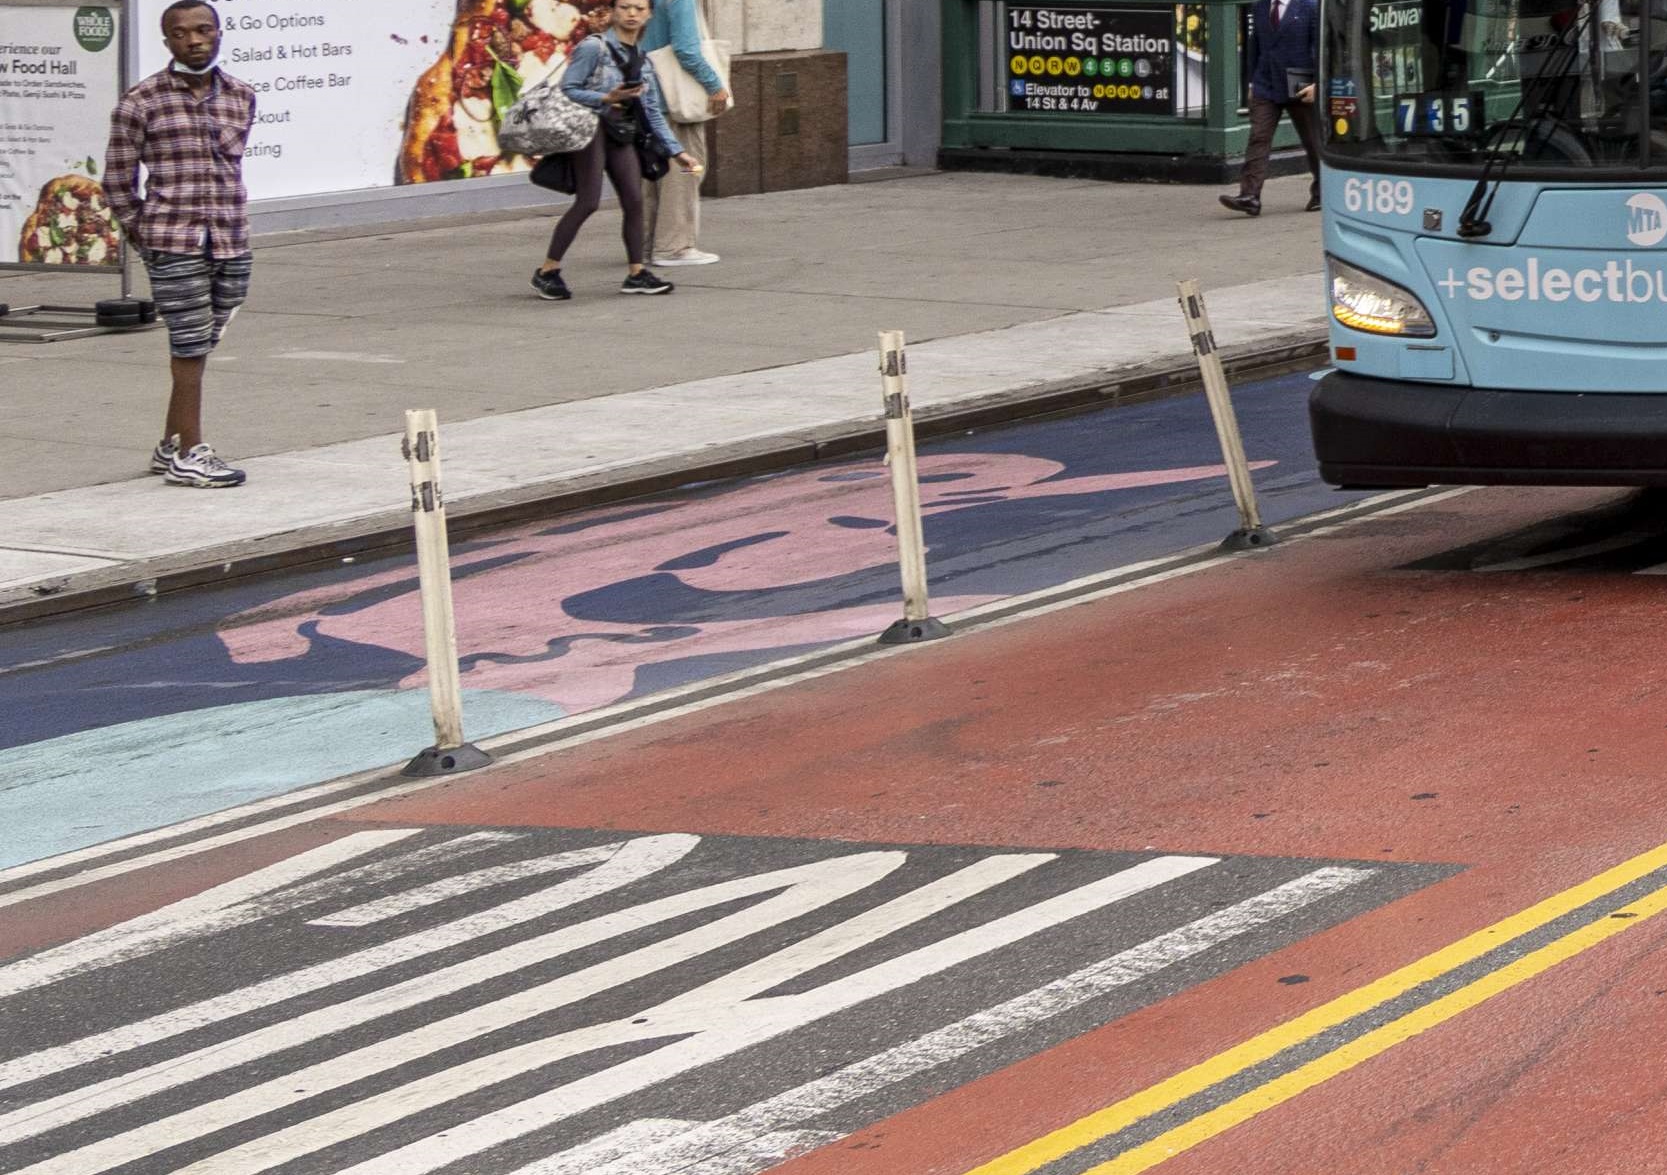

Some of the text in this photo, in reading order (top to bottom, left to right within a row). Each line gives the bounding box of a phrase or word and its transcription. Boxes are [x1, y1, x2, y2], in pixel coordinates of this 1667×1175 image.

[225, 13, 326, 31] & Go Options
[1009, 10, 1102, 30] 14 Street-
[41, 46, 62, 55] our
[1009, 31, 1170, 56] Union Sq Station
[231, 43, 353, 63] Salad & Hot Bars
[12, 59, 77, 75] Food Hall
[274, 75, 325, 92] Coffee
[328, 74, 352, 88] Bar
[1025, 83, 1169, 99] Elevator to at
[1025, 97, 1099, 111] 14 St & 4 Av
[1344, 176, 1414, 215] 6189
